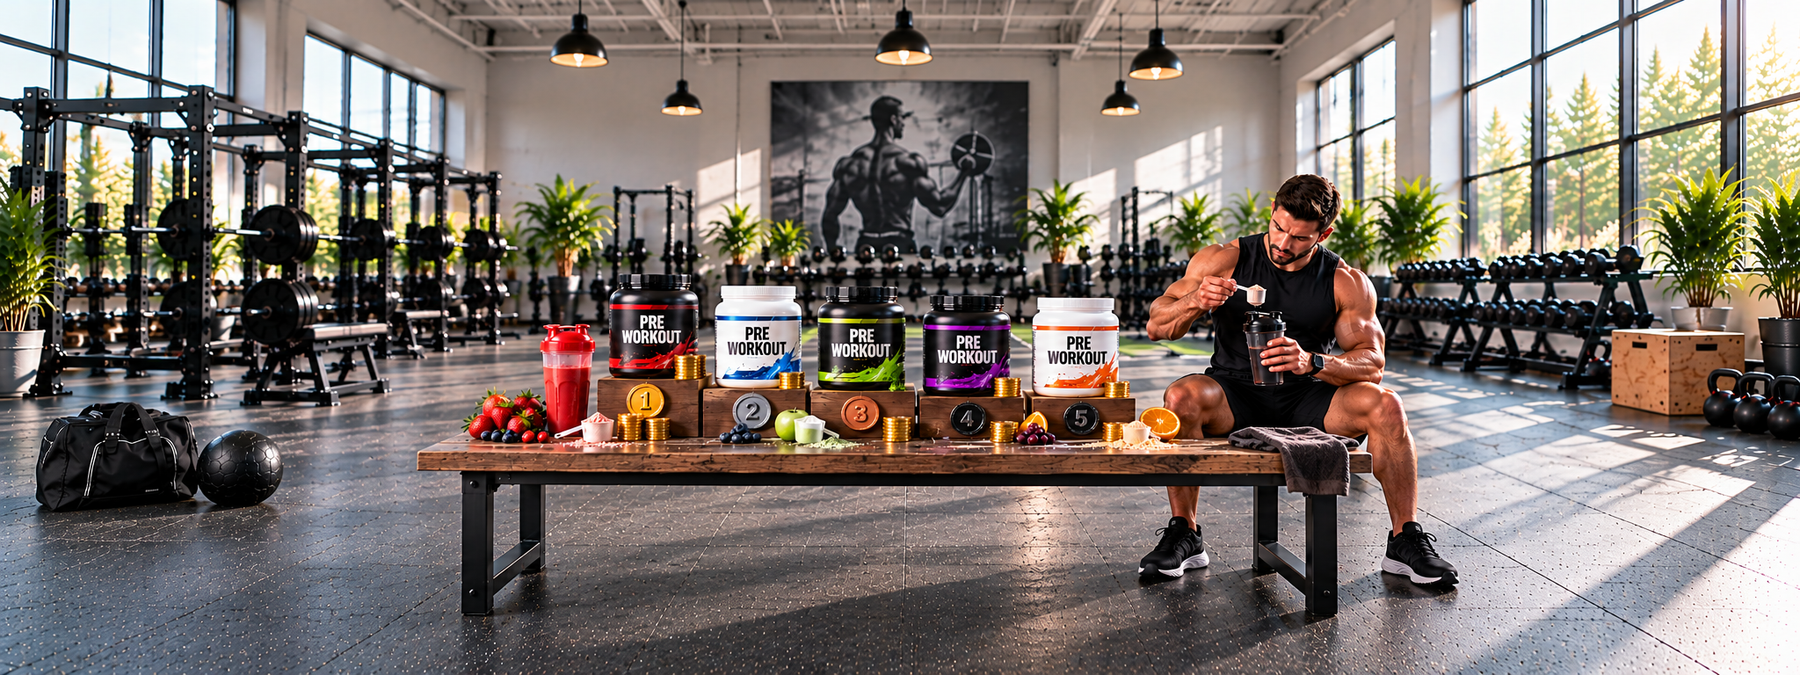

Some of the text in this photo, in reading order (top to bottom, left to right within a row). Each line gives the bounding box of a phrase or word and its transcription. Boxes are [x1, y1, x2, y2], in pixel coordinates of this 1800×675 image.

[640, 315, 665, 329] PRE
[622, 329, 681, 344] WORKOUT
[745, 326, 770, 341] PRE
[849, 328, 875, 343] PRE
[727, 341, 787, 356] WORKOUT
[956, 335, 981, 350] PRE
[1066, 336, 1092, 350] PRE
[831, 343, 891, 358] WORKOUT
[937, 349, 998, 364] WORKOUT
[1047, 350, 1108, 365] WORKOUT
[640, 391, 651, 410] 1
[745, 401, 760, 421] 2
[853, 404, 868, 422] 3
[960, 409, 974, 427] 4
[1074, 409, 1088, 427] 5
